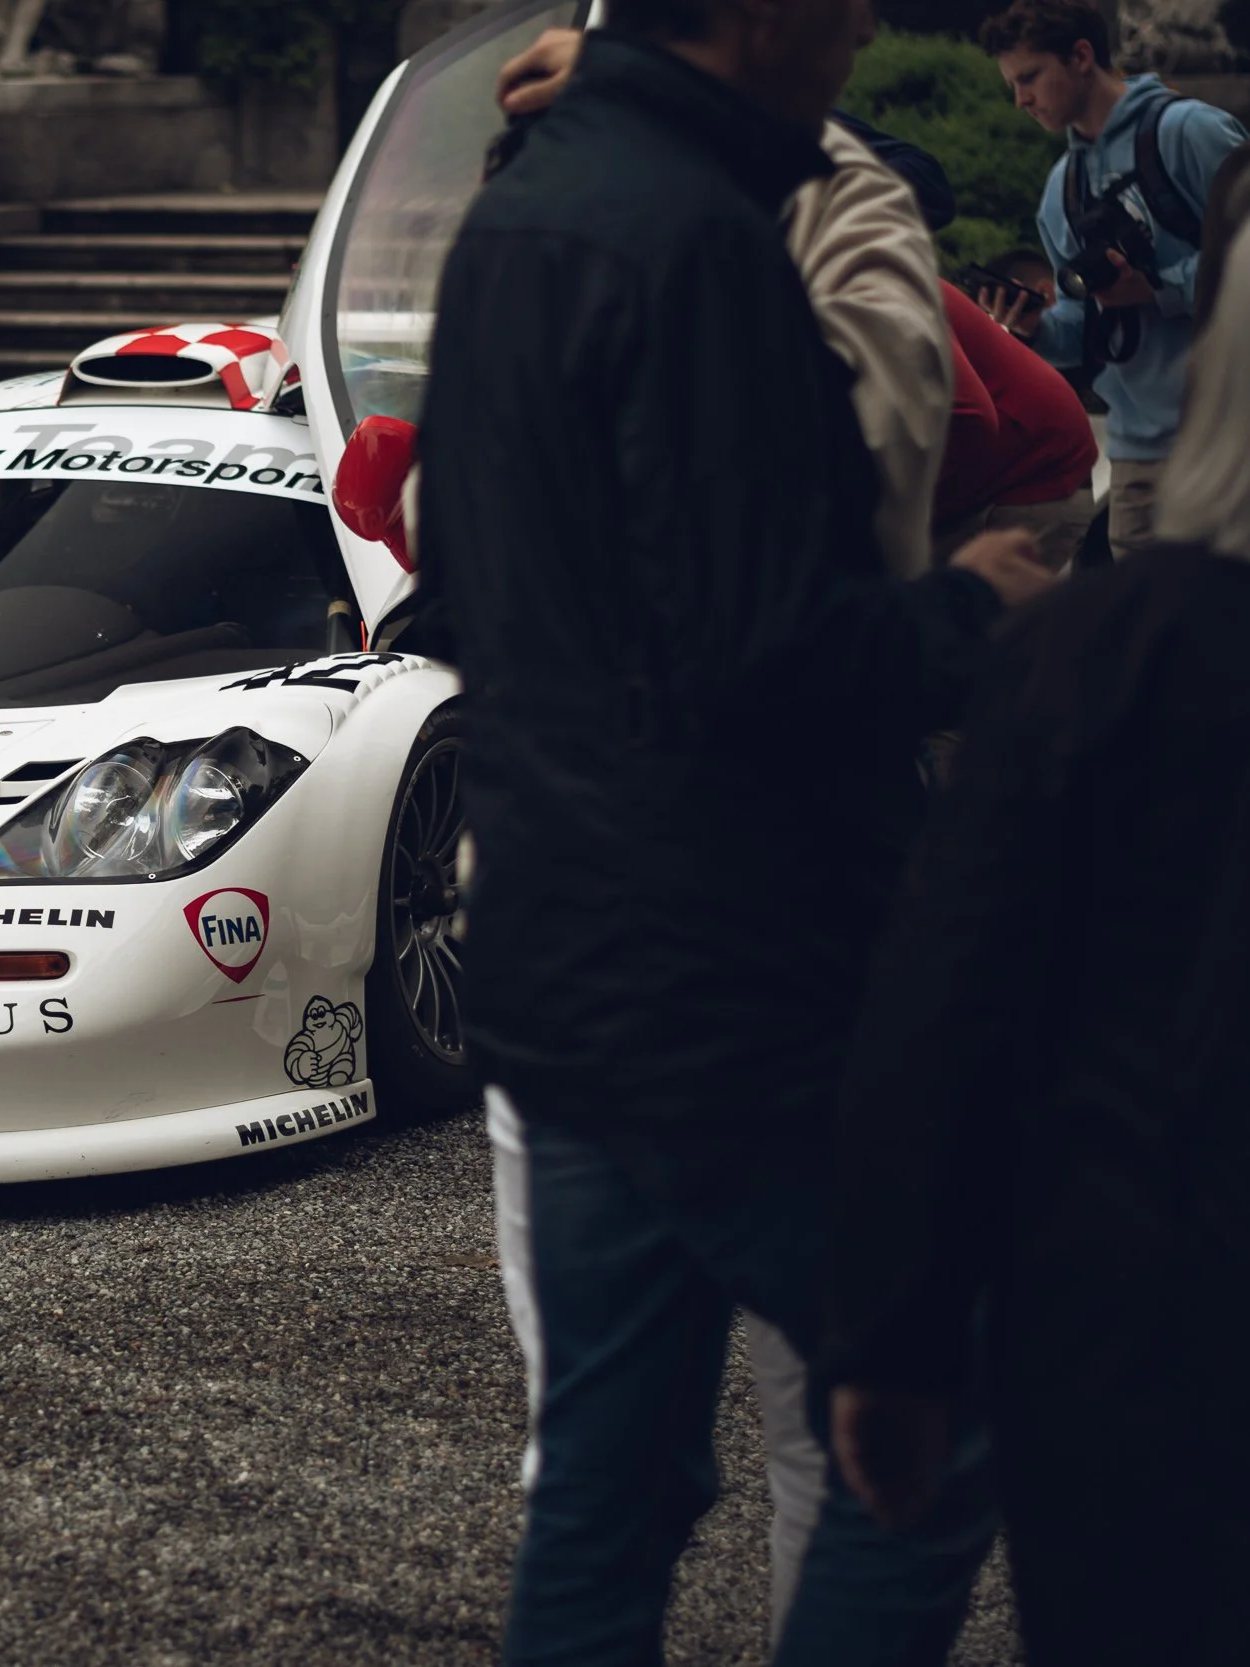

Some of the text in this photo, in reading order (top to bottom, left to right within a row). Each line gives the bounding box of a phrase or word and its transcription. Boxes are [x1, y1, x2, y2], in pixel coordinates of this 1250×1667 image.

[5, 448, 324, 494] Motorspor
[13, 423, 321, 491] Team
[201, 914, 262, 947] FINA
[235, 1091, 369, 1147] MICHELIN
